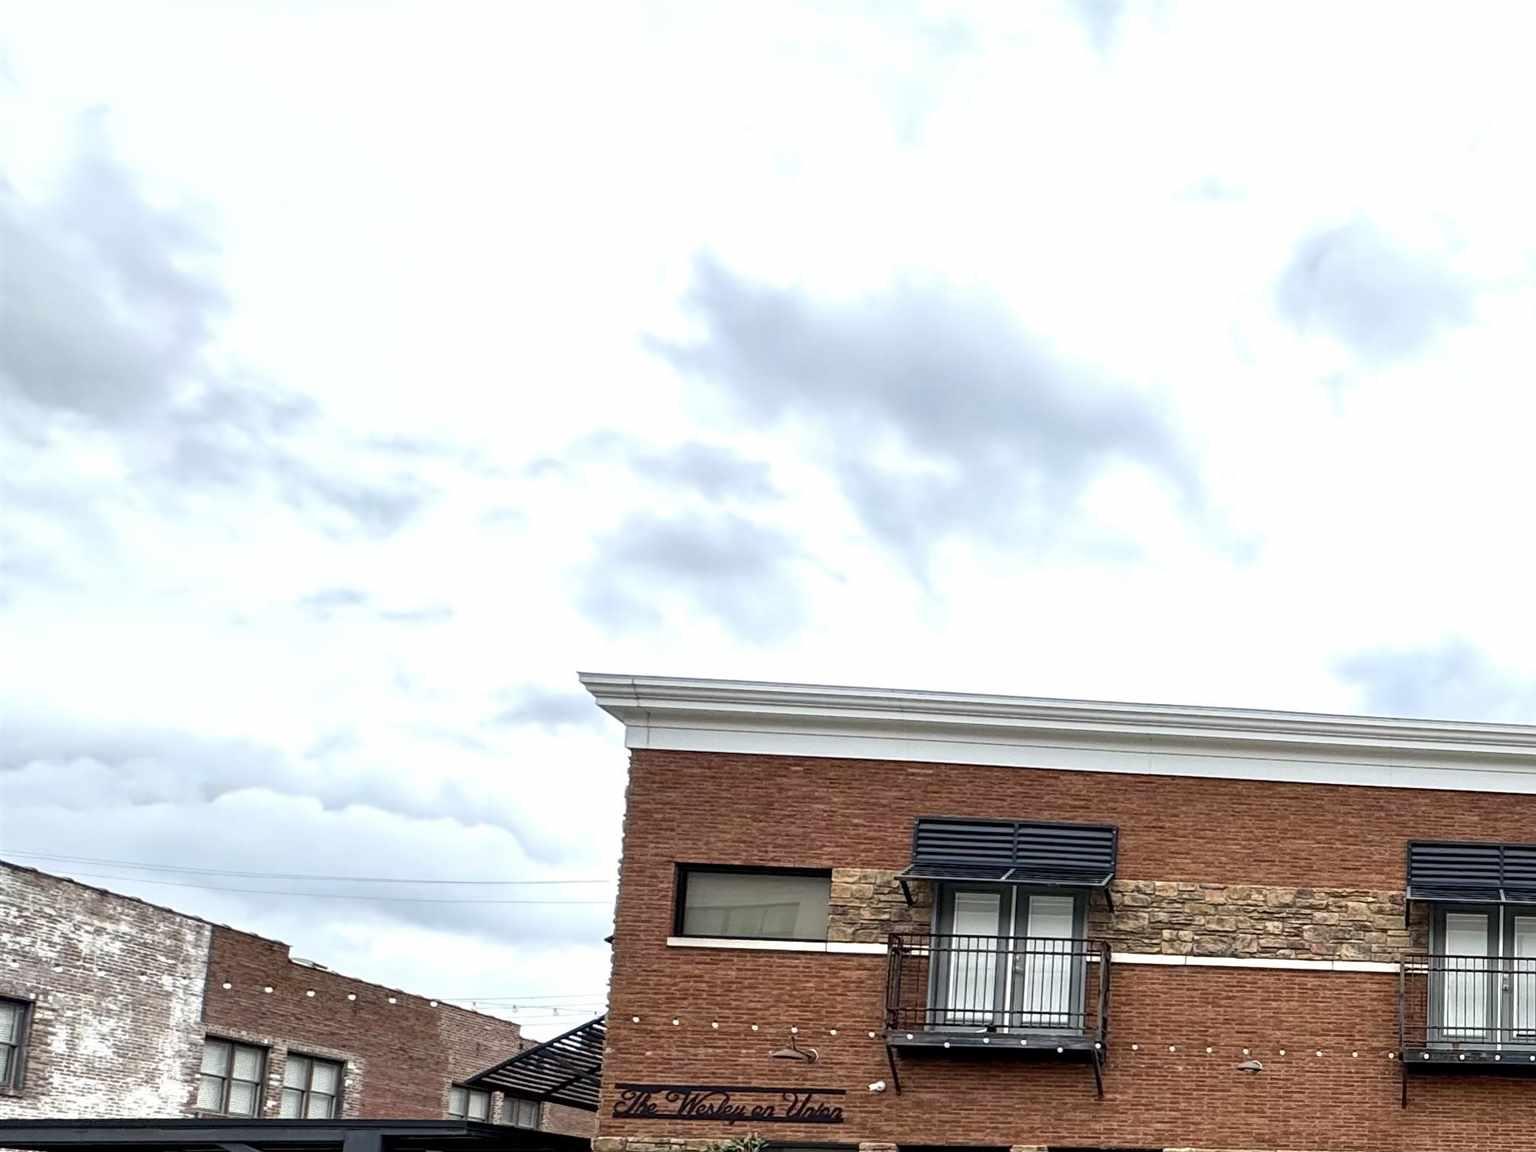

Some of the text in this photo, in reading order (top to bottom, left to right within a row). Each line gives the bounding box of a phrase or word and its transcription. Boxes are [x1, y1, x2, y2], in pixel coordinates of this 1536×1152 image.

[613, 1089, 844, 1125] The Wesley on Union
